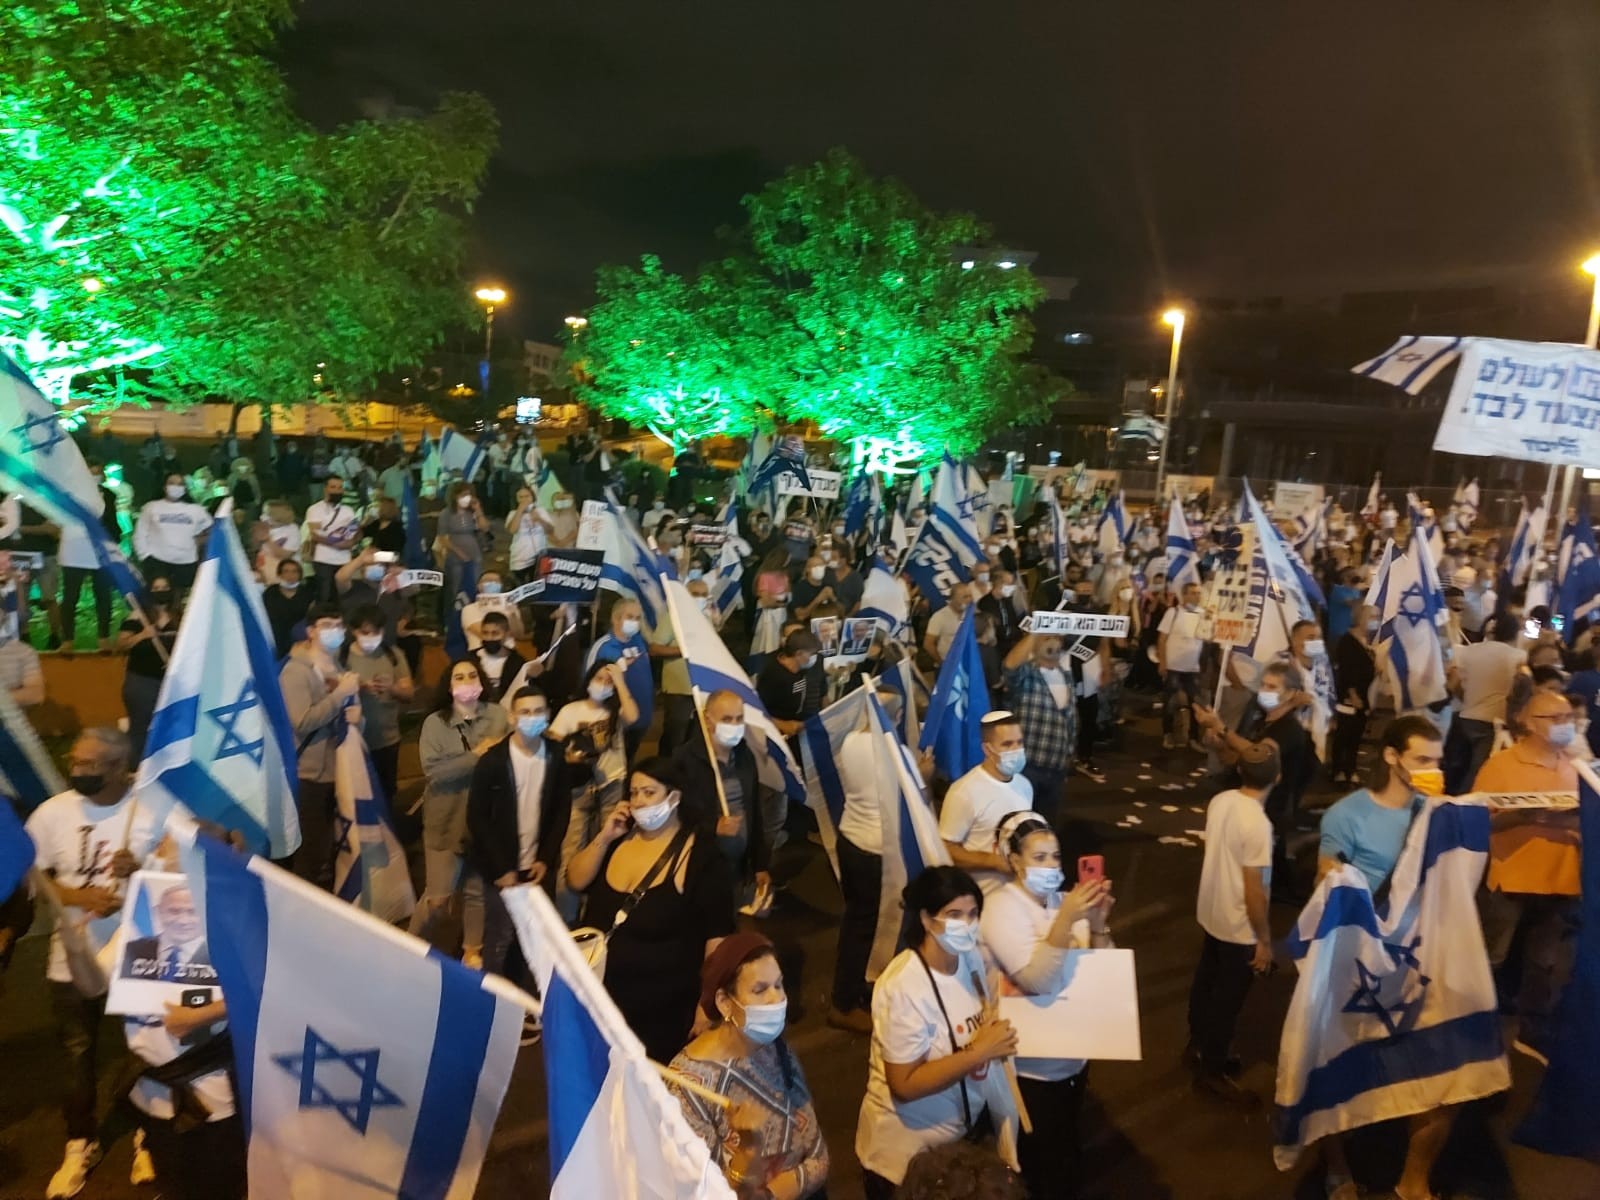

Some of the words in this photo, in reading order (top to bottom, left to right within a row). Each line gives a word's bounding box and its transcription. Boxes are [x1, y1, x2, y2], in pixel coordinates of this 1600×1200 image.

[1033, 615, 1071, 631] הריבון
[1074, 617, 1096, 630] הוא
[1100, 618, 1125, 631] העם
